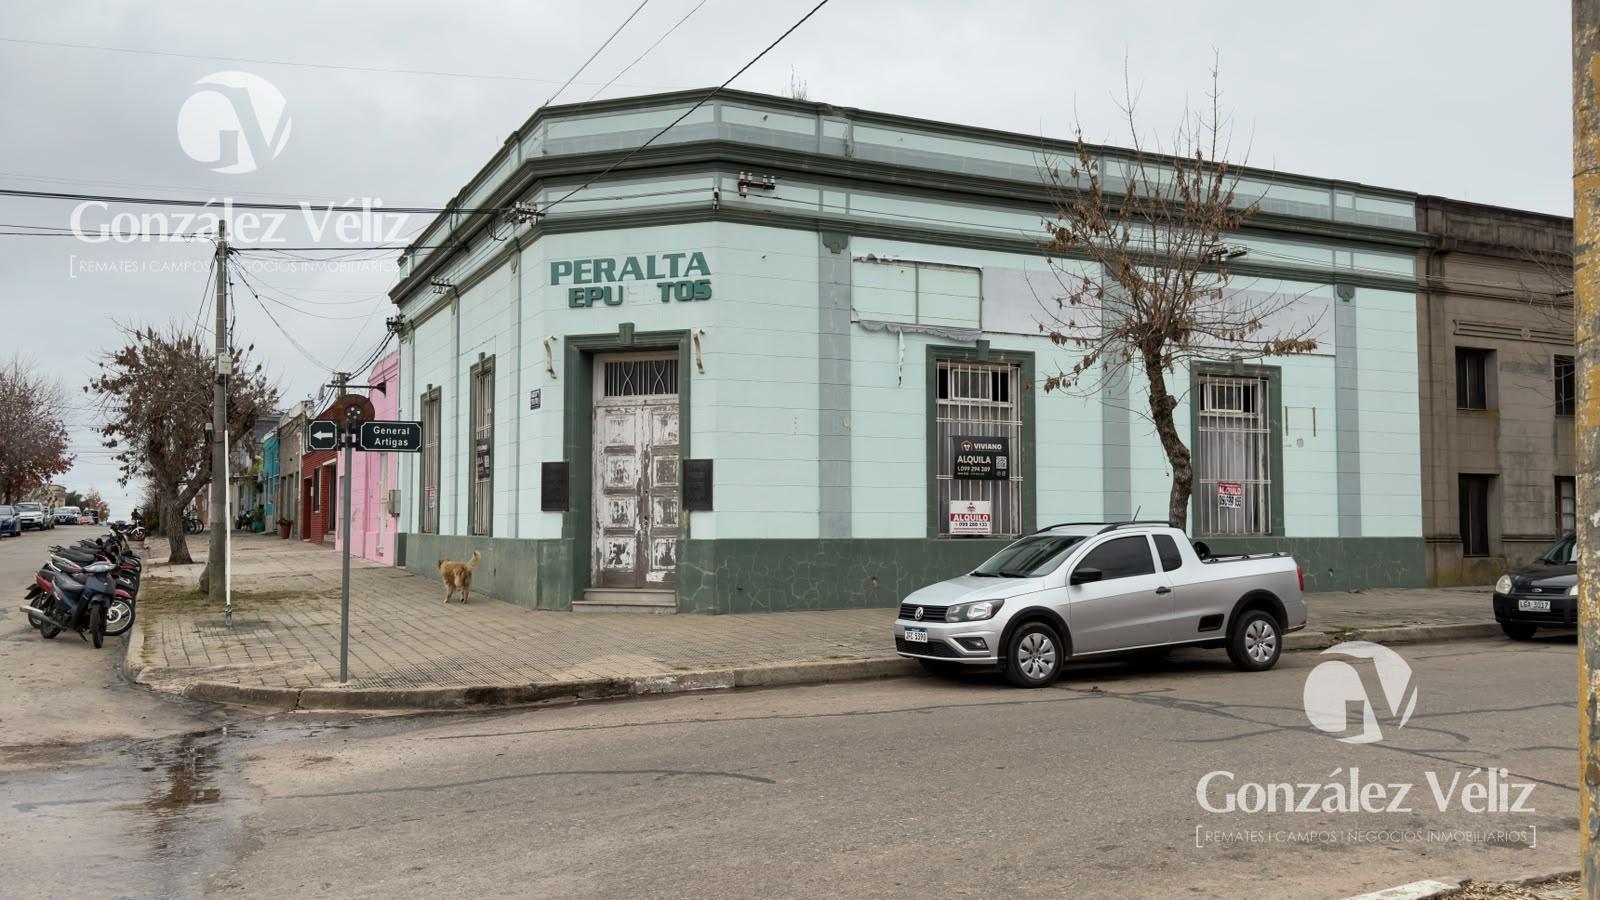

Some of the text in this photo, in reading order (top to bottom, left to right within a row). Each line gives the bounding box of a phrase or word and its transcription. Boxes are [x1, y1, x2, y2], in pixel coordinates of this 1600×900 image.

[550, 251, 712, 286] PERALTA
[373, 425, 410, 435] General
[374, 437, 408, 447] Artigas
[957, 455, 991, 465] ALQUILA
